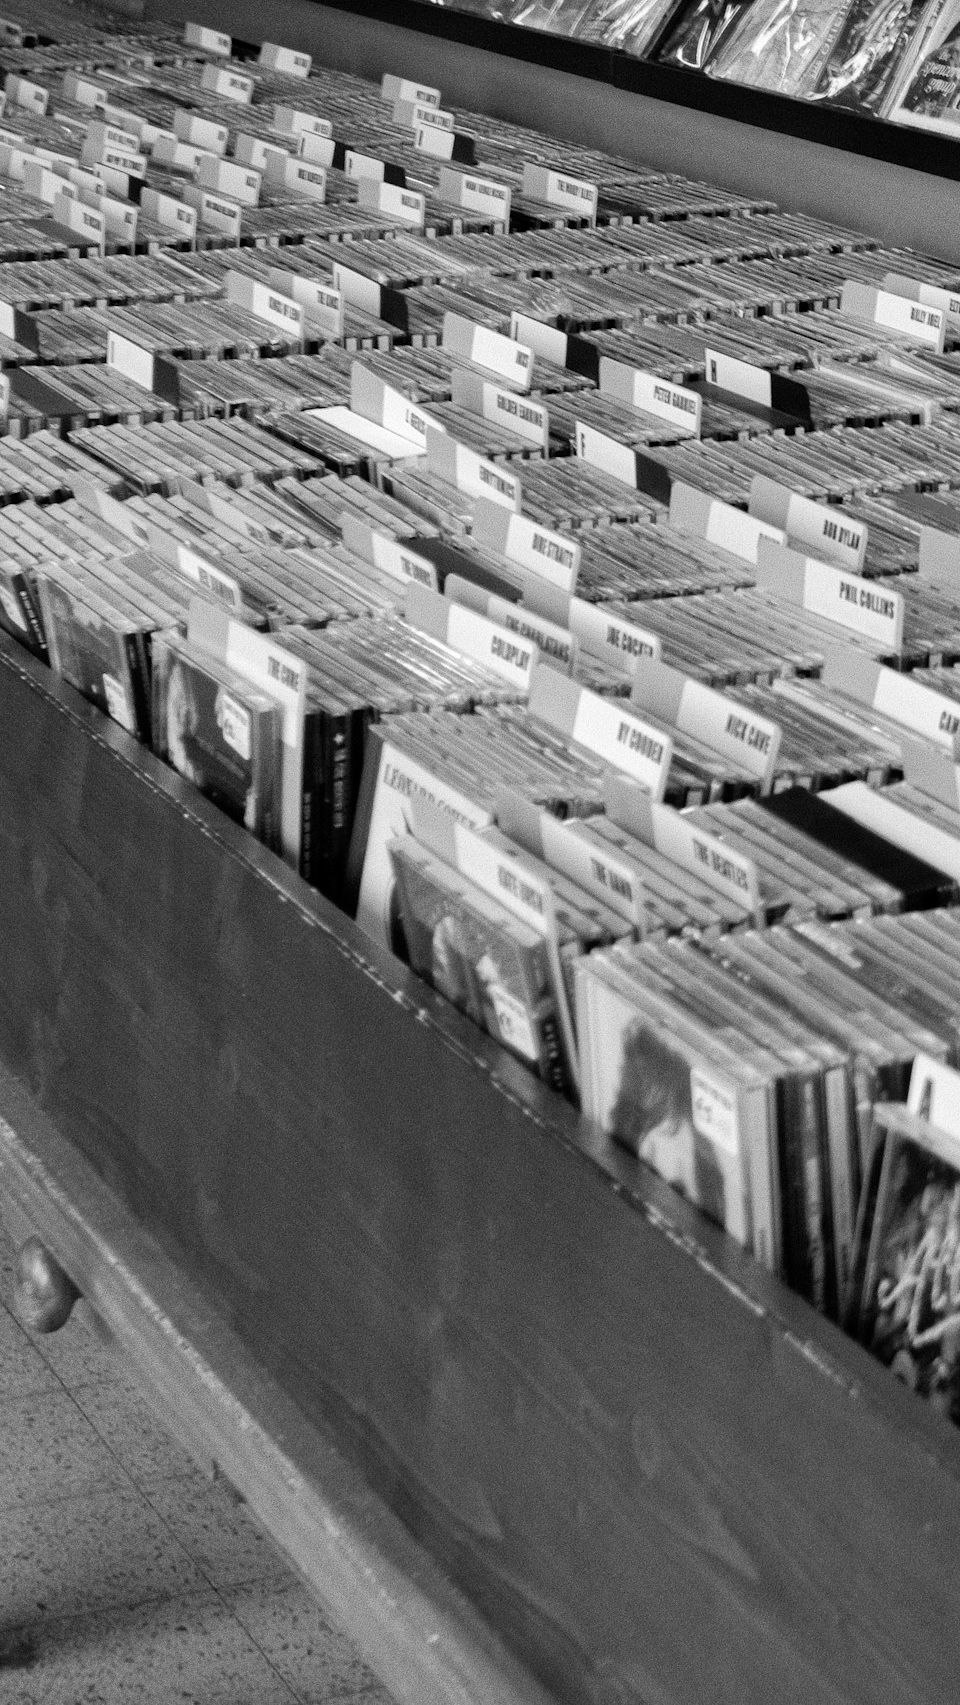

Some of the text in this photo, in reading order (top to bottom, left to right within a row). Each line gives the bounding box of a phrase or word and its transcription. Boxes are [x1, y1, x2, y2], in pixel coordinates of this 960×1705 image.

[910, 307, 941, 328] BILLY JOEL
[653, 384, 698, 415] PETER GABRIEL
[531, 532, 574, 570] DIRE STRAITS
[823, 518, 861, 551] BOB DYLAN
[839, 580, 895, 620] PHIL COLLINS
[490, 634, 530, 672] COLDPLAY
[606, 624, 621, 648] JOE
[616, 721, 664, 766] RY COODER
[724, 712, 771, 756] NICK CAVE
